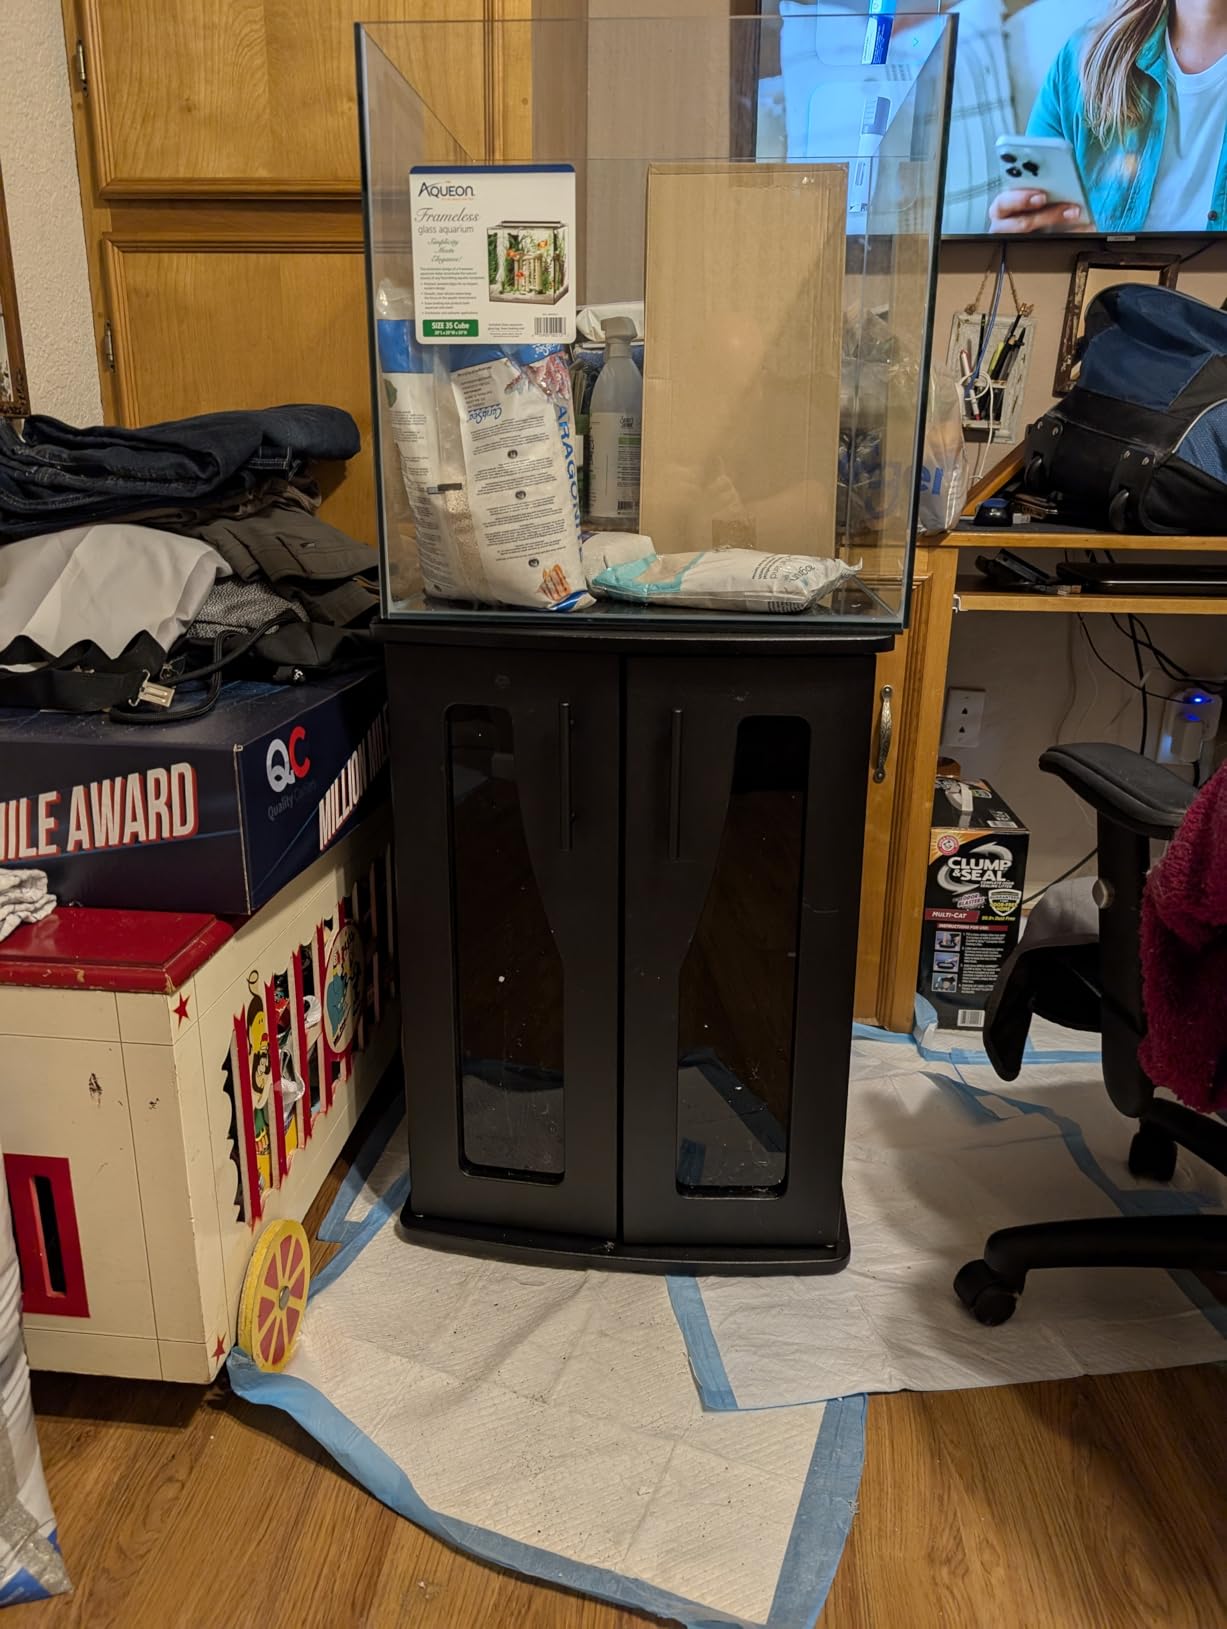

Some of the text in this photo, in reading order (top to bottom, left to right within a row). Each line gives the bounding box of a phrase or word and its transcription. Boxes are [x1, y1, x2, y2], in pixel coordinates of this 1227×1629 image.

[418, 181, 474, 199] AQUEON
[415, 207, 480, 222] Frameless
[418, 225, 474, 236] glass aquarium
[431, 322, 470, 330] SIZE 35 Cube
[266, 725, 311, 793] QC
[318, 736, 368, 852] MILLION
[67, 762, 199, 852] AWARD
[947, 857, 1012, 871] CLUMP
[931, 911, 967, 919] MULTI-CAT
